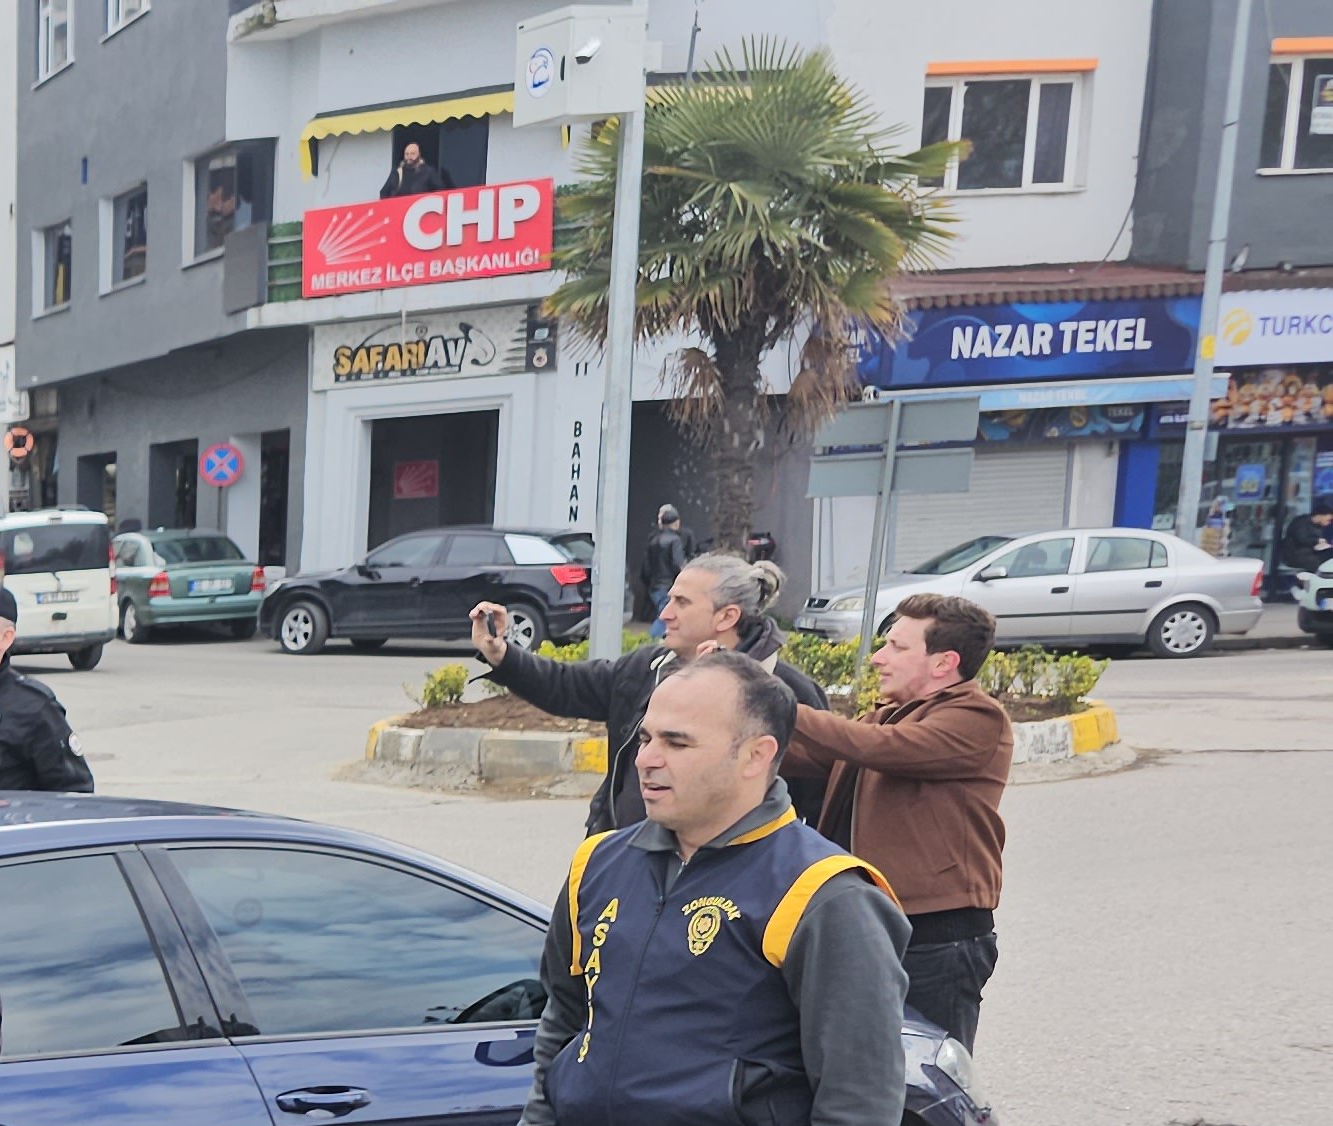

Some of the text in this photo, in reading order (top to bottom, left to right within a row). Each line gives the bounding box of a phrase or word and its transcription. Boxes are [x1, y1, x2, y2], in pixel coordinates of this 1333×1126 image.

[402, 184, 541, 251] CHP
[311, 266, 383, 291] MERKEZ
[386, 261, 425, 283] İLÇE
[951, 317, 1153, 360] NAZAR TEKEL
[681, 896, 742, 921] ZONGULDAK
